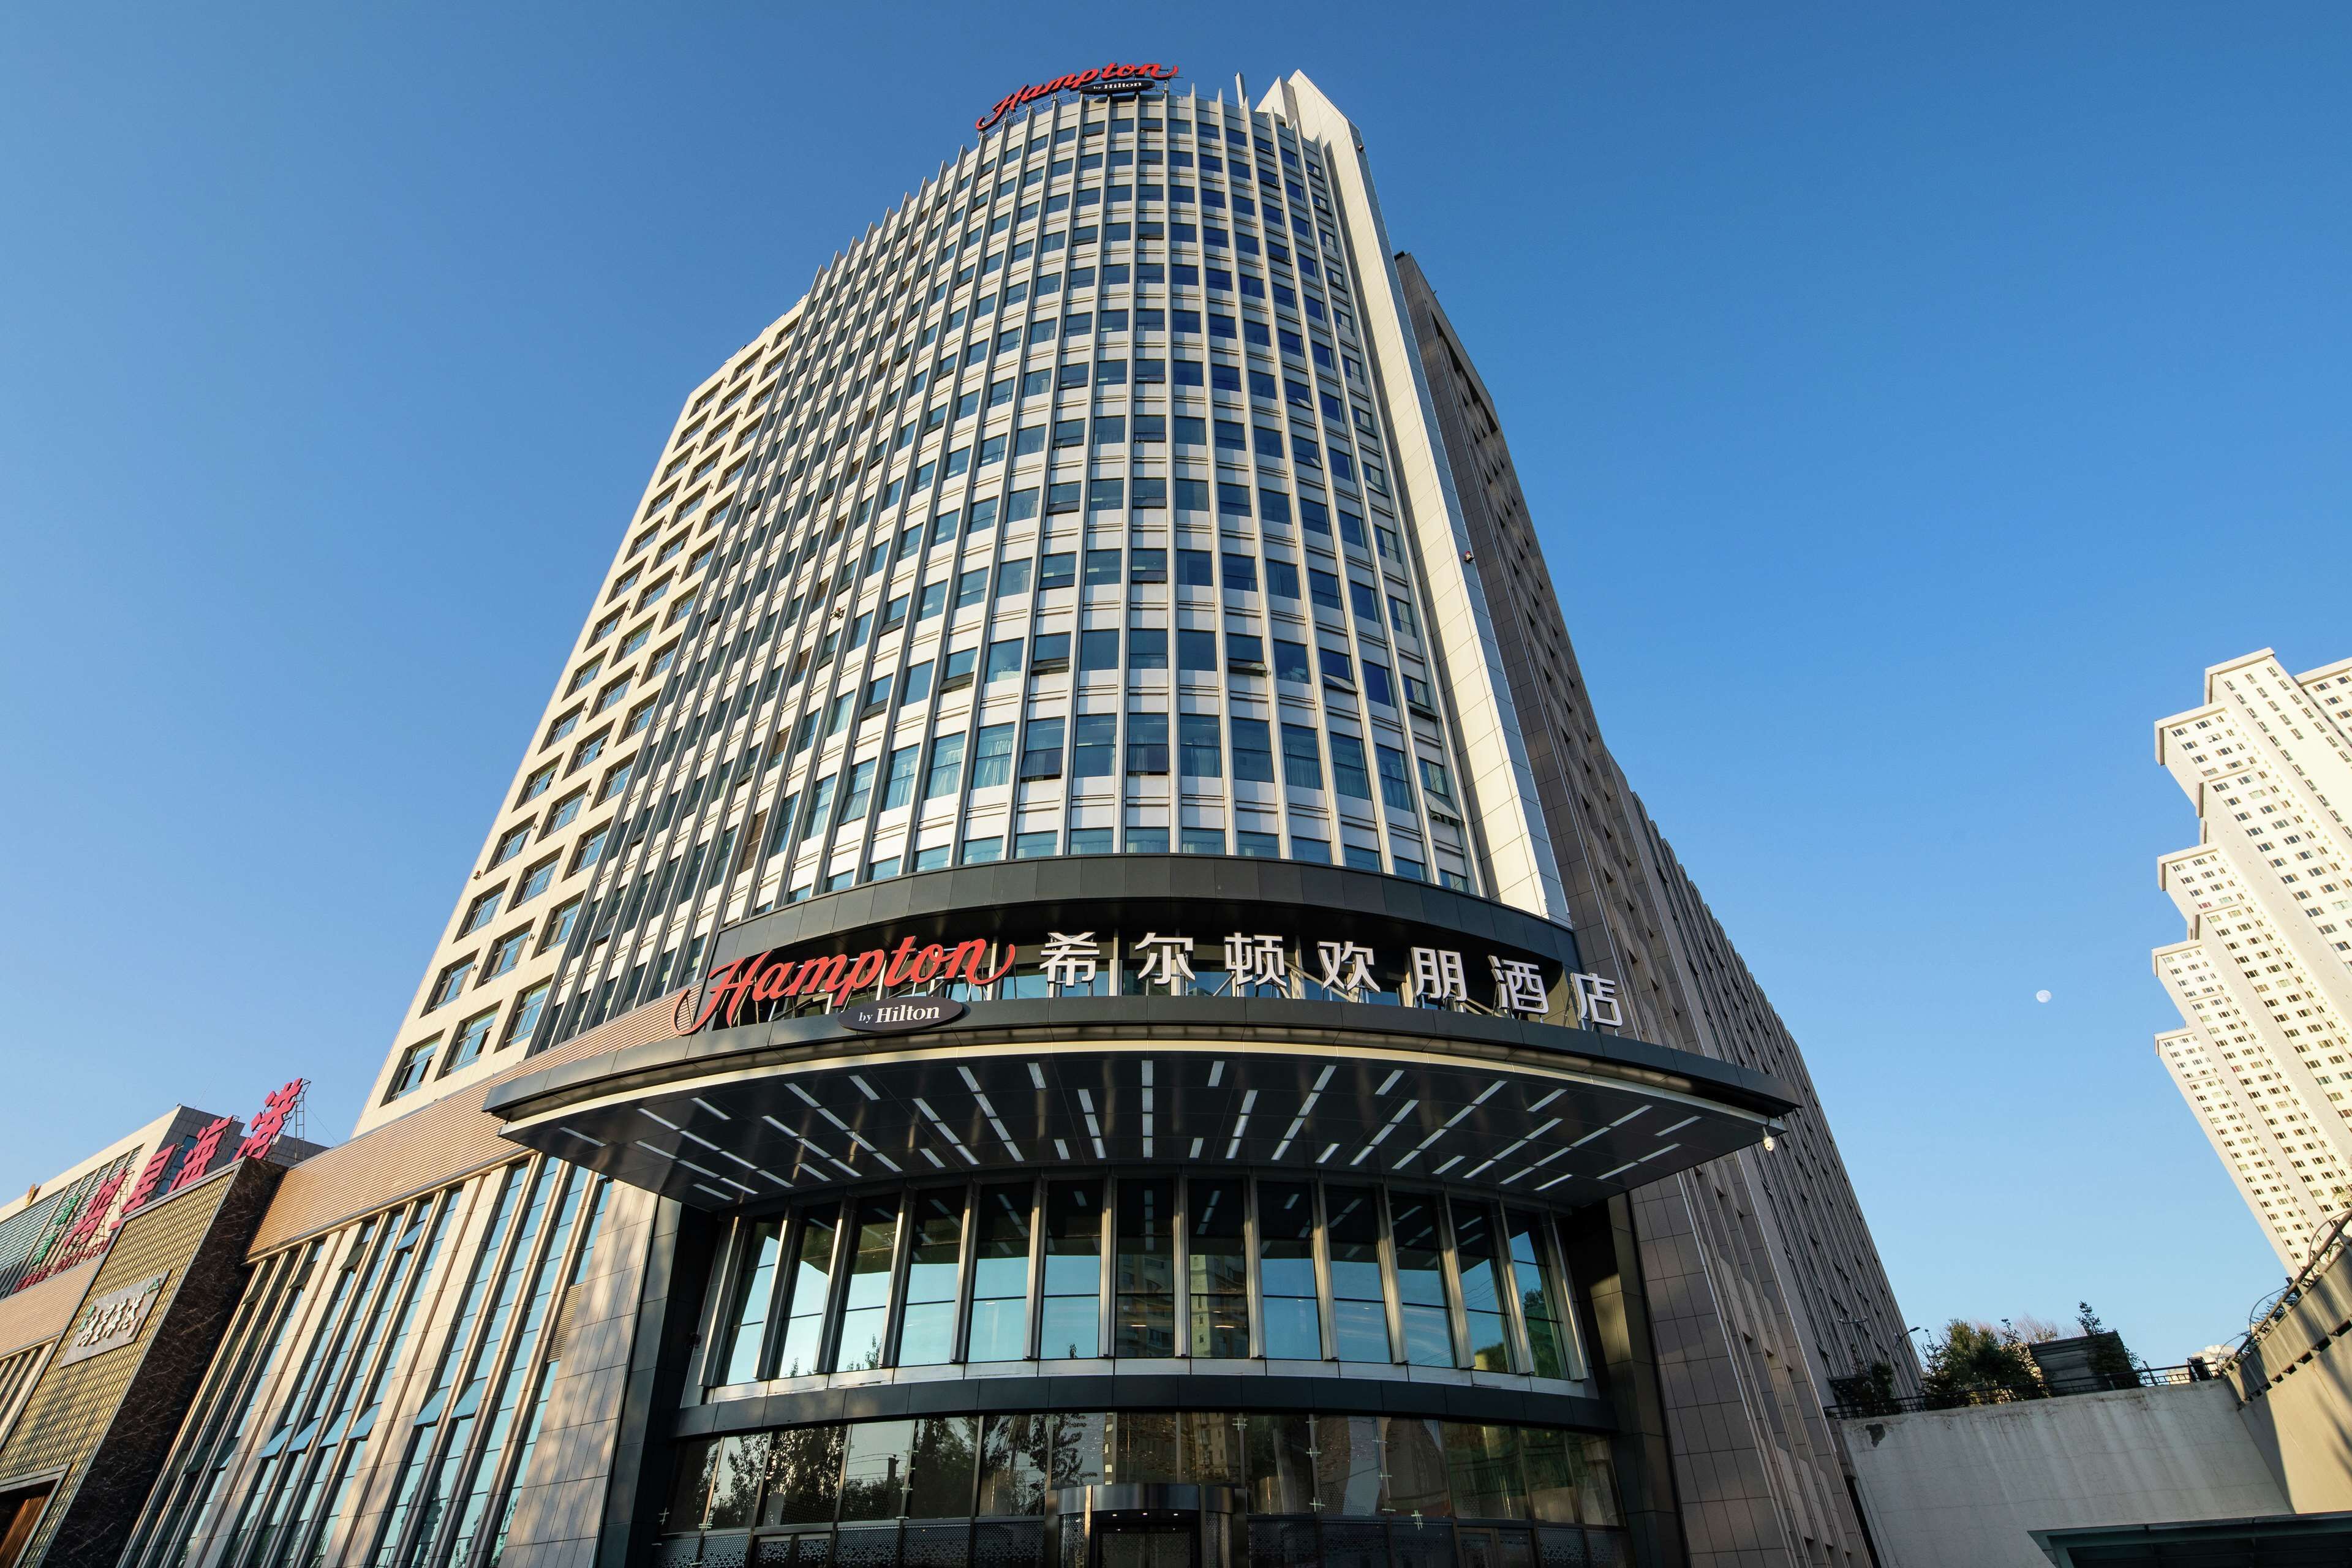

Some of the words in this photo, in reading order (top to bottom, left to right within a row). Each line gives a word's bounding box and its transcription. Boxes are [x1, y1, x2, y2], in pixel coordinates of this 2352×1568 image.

[975, 62, 1179, 130] Hampton
[1103, 81, 1142, 89] Hilton
[671, 935, 1016, 1035] Hampton
[1039, 932, 1623, 1027] 希尔顿欢朋酒店
[859, 1011, 873, 1024] by
[875, 1004, 940, 1024] Hilton
